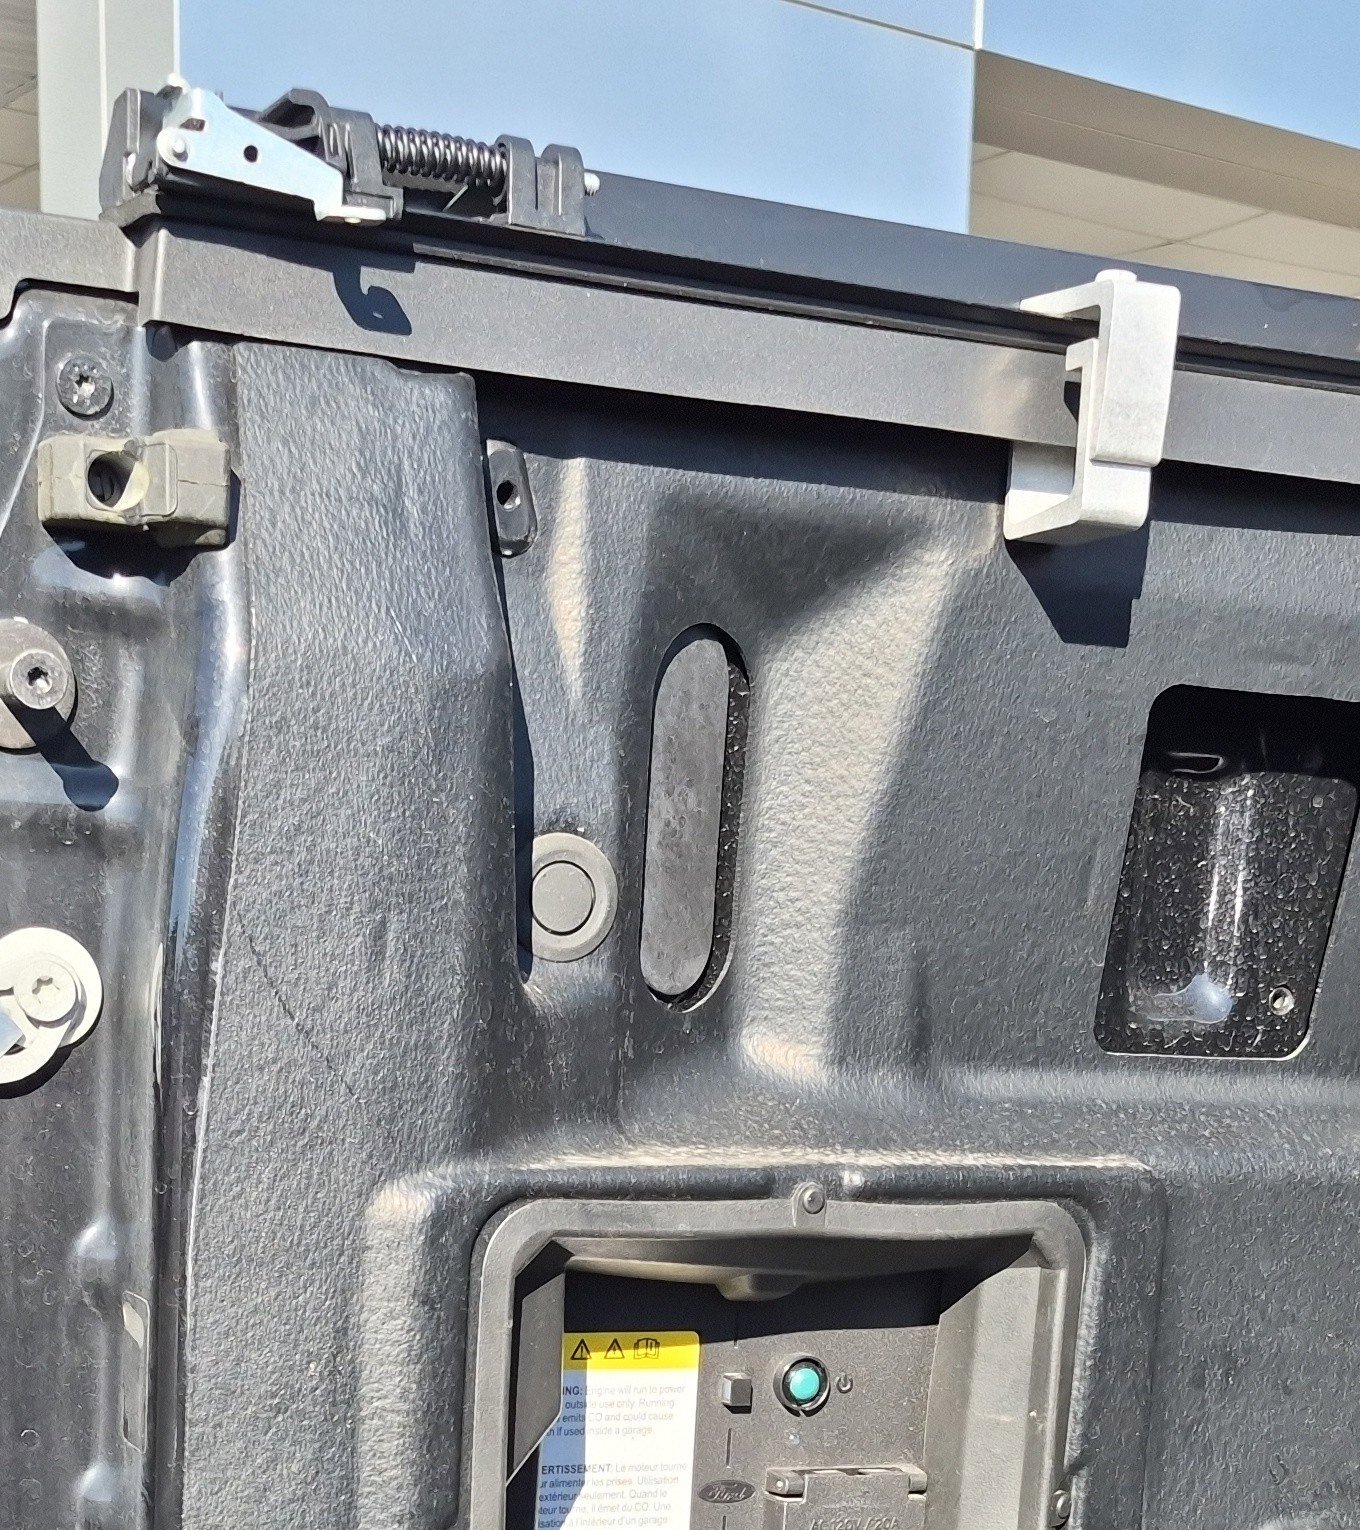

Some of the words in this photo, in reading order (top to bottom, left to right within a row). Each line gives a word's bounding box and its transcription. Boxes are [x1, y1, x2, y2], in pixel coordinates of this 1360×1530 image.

[562, 1386, 583, 1396] ING:
[619, 1385, 631, 1394] will
[633, 1386, 647, 1394] run
[638, 1398, 674, 1409] Running
[604, 1412, 621, 1421] and
[623, 1411, 646, 1421] could
[563, 1426, 585, 1436] used
[541, 1463, 612, 1474] ERTISSEMENT:
[539, 1491, 577, 1501] extérieur
[629, 1489, 657, 1500] Quand
[539, 1506, 557, 1515] teur
